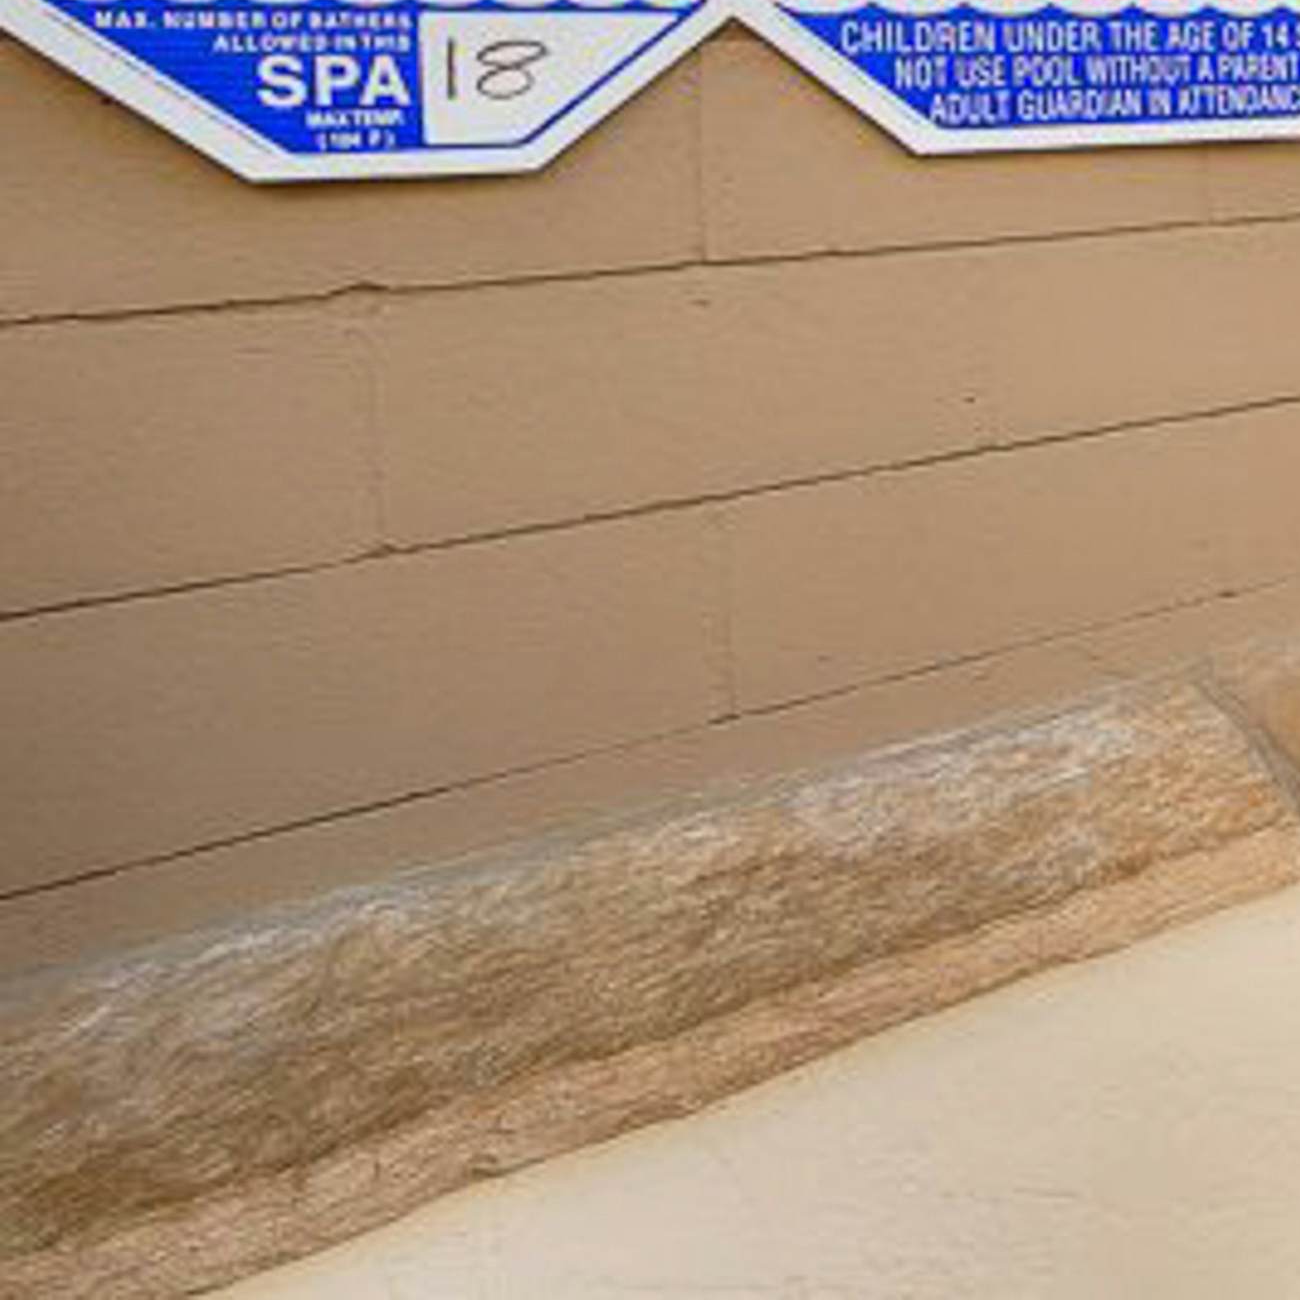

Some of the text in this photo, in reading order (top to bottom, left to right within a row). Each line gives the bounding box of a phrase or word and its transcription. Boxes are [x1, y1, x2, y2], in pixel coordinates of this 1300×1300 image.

[163, 10, 271, 30] NUMBER
[271, 10, 303, 29] OF
[307, 10, 413, 30] BATHERS
[840, 20, 998, 53] CHILDREN
[1003, 20, 1099, 53] UNDER
[1109, 20, 1157, 51] THE
[1167, 20, 1218, 51] AGE
[1223, 21, 1257, 51] OF
[1261, 22, 1288, 50] 14
[211, 33, 324, 52] ALLOWED
[256, 53, 412, 108] SPA
[447, 36, 549, 100] 18
[894, 56, 950, 89] NOT
[954, 56, 1006, 88] USE
[1012, 56, 1083, 87] POOL
[1086, 54, 1192, 85] WITHOUT
[1196, 54, 1216, 83] A
[1217, 52, 1300, 83] PARENT
[928, 94, 1011, 126] ADULT
[1017, 91, 1141, 123] GUARDIAN
[1147, 90, 1171, 118] IN
